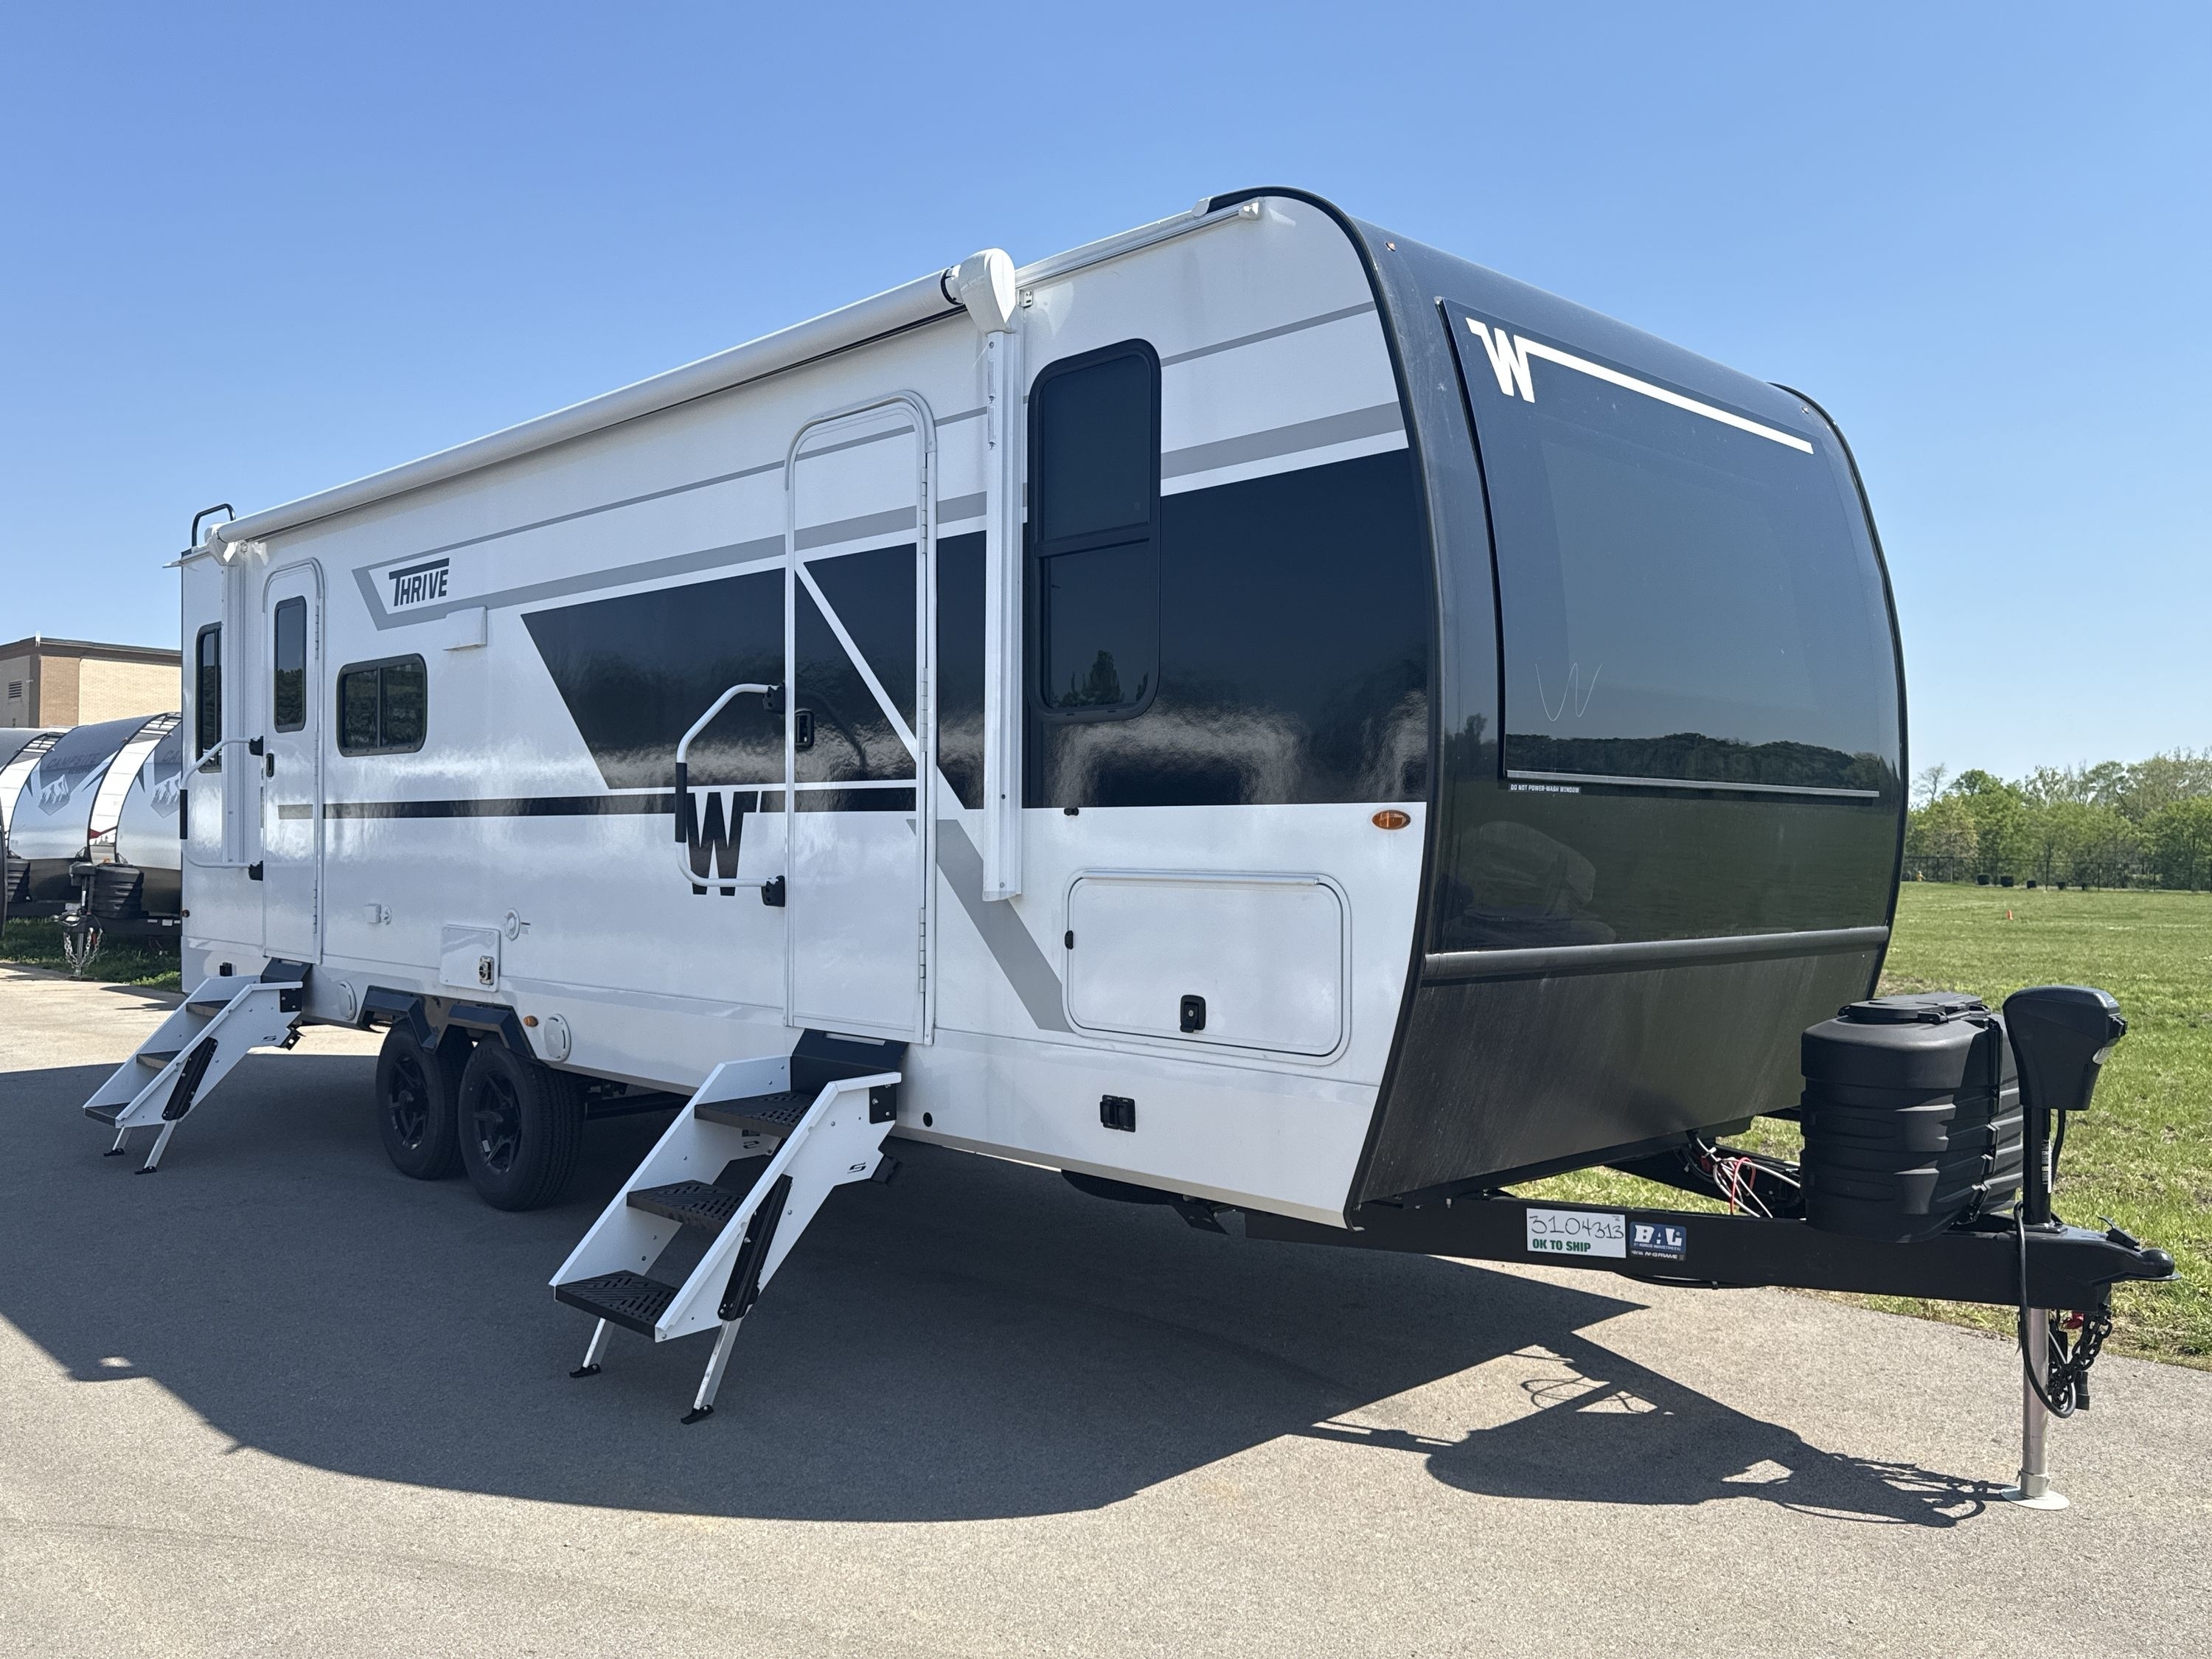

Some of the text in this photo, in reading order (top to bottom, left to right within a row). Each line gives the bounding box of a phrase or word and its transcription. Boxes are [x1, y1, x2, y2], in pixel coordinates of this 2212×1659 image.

[389, 557, 450, 607] THRIVE
[1528, 1215, 1624, 1239] 3104313
[1532, 1239, 1591, 1253] OK TO SHIP
